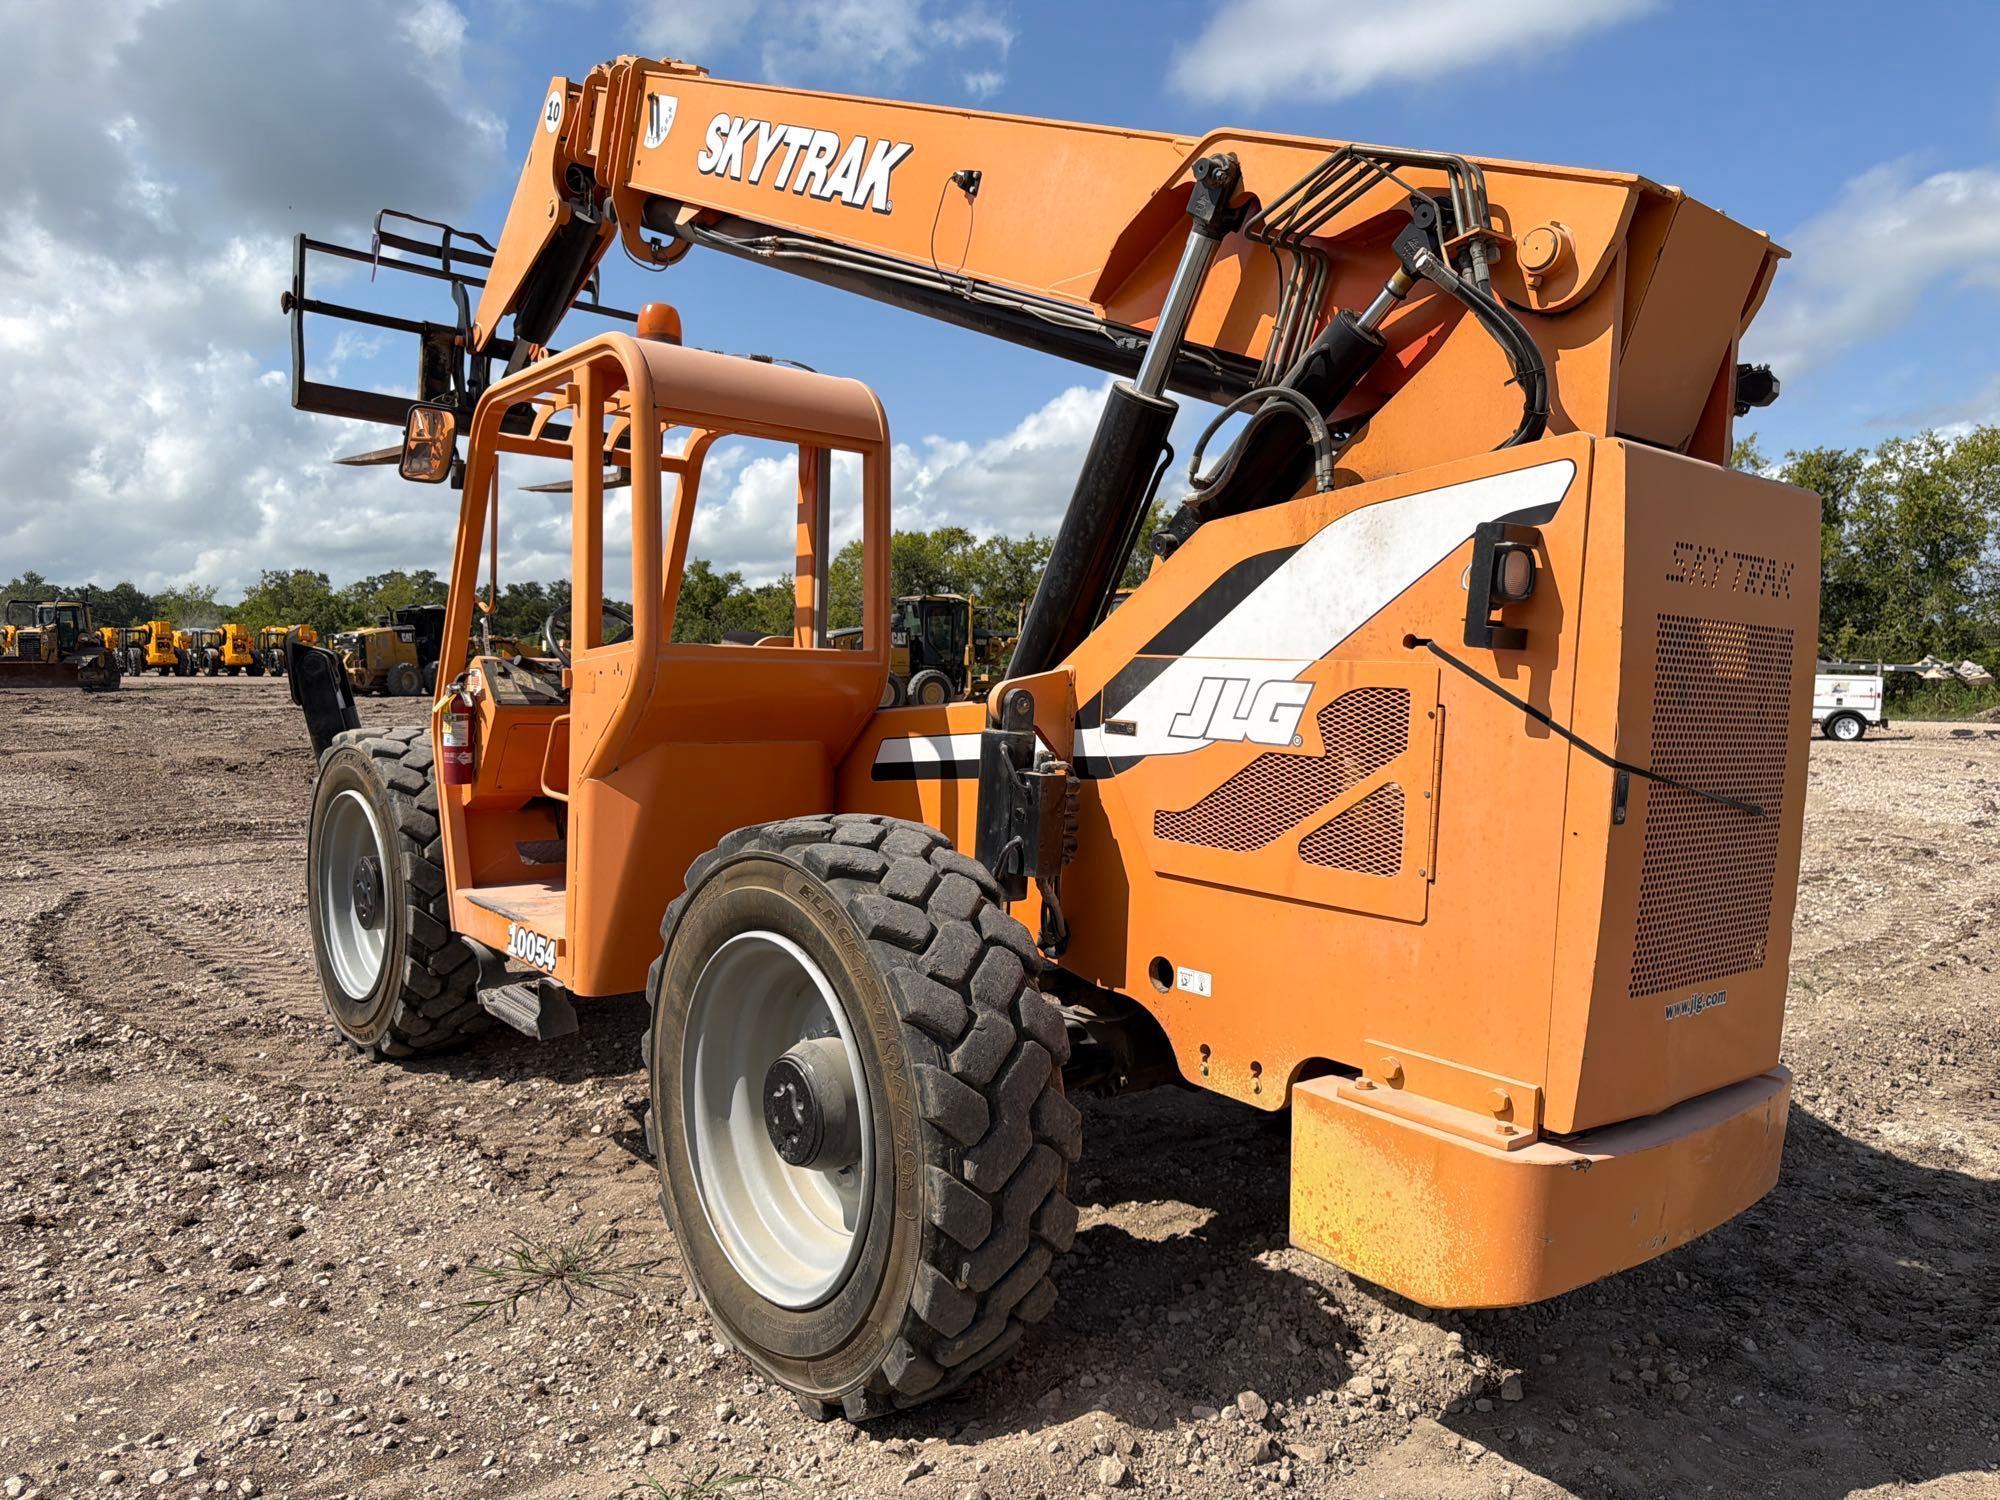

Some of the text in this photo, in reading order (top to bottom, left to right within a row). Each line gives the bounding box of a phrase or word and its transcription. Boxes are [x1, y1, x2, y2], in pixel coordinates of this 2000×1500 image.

[546, 100, 561, 122] 10
[697, 112, 914, 213] SKYTRAK
[891, 632, 907, 645] CAT
[1167, 676, 1316, 747] JLG
[506, 922, 556, 974] 10054
[1665, 990, 1727, 1019] www.jlg.com
